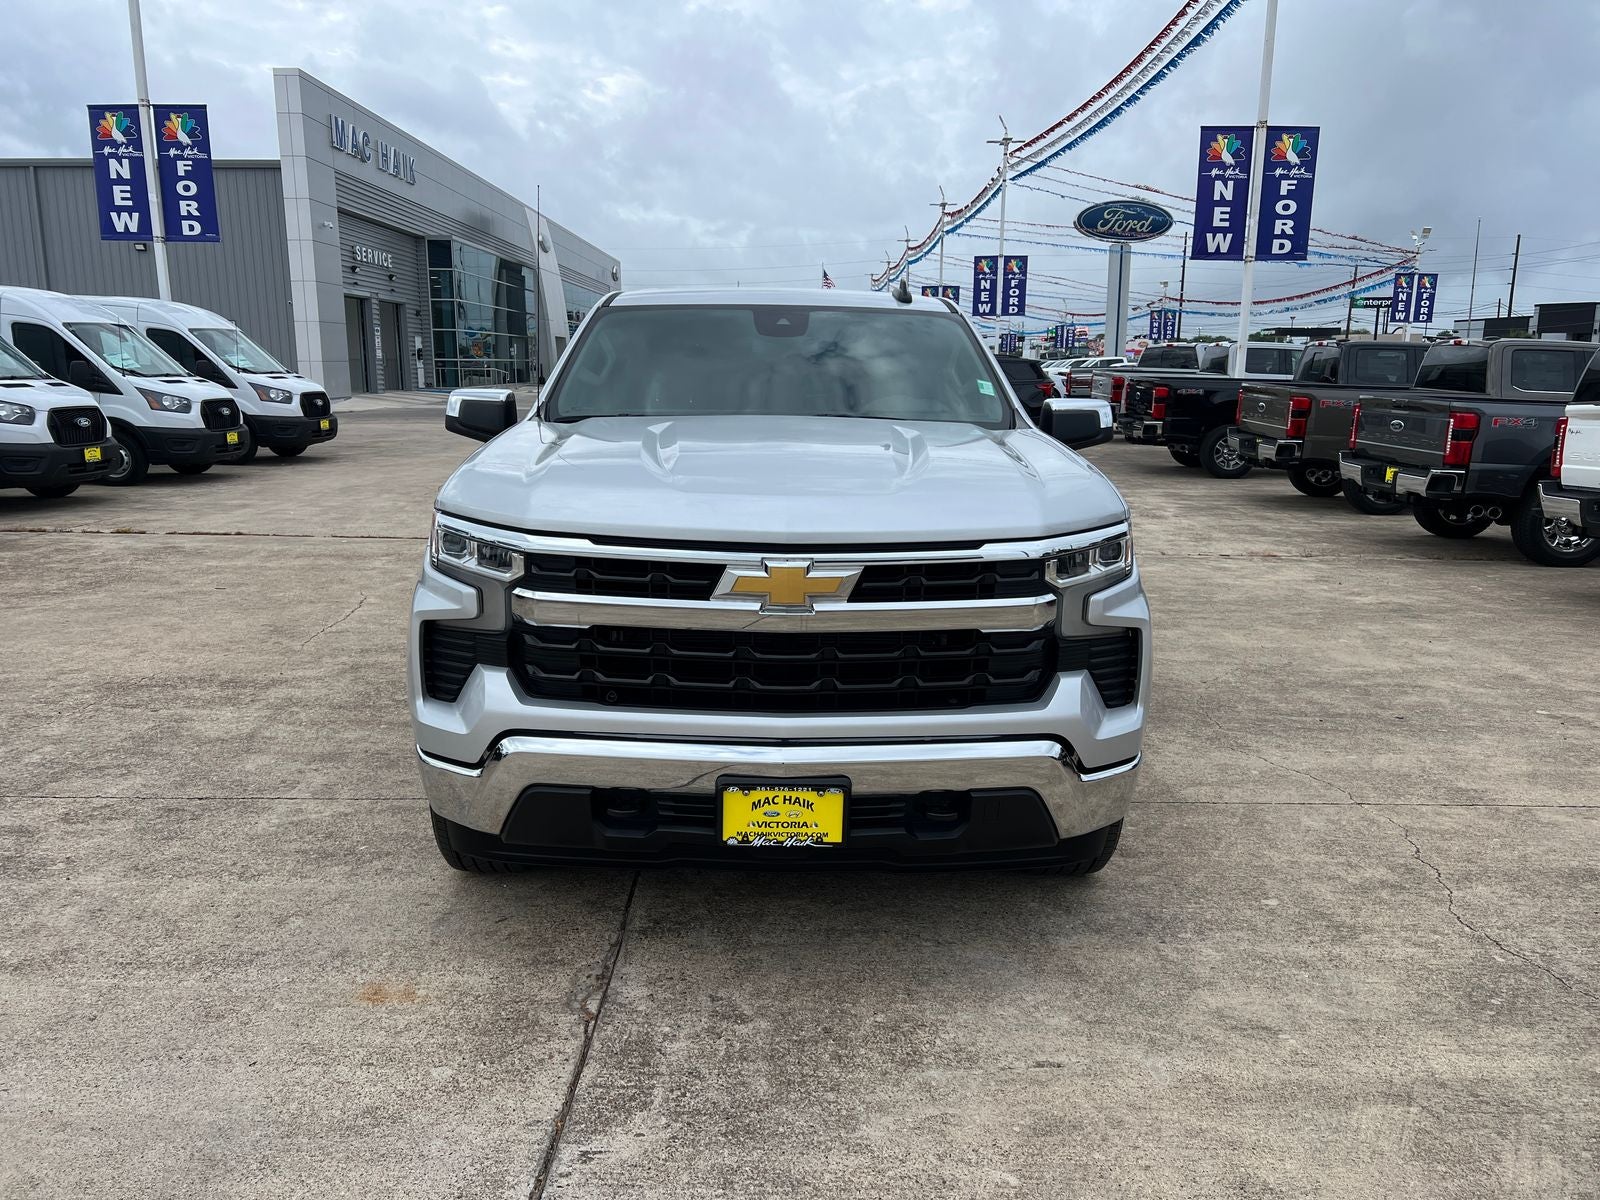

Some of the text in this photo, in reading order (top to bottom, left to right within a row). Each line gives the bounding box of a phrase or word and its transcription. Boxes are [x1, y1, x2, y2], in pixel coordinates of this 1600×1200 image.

[330, 113, 417, 186] MAC HAIK
[108, 158, 139, 233] NEW
[175, 160, 202, 236] FORD
[1097, 207, 1153, 232] Ford
[1206, 180, 1234, 253] NEW
[1271, 180, 1298, 254] FORD
[355, 245, 393, 268] SERVICE
[978, 280, 991, 313] NEW
[1008, 280, 1020, 314] FORD
[1395, 292, 1407, 320] NEW
[1419, 292, 1431, 321] FORD
[1151, 322, 1159, 339] NEW
[1492, 417, 1538, 428] FX4
[751, 795, 814, 812] MAC HAIK
[750, 836, 815, 847] Mac Haik
